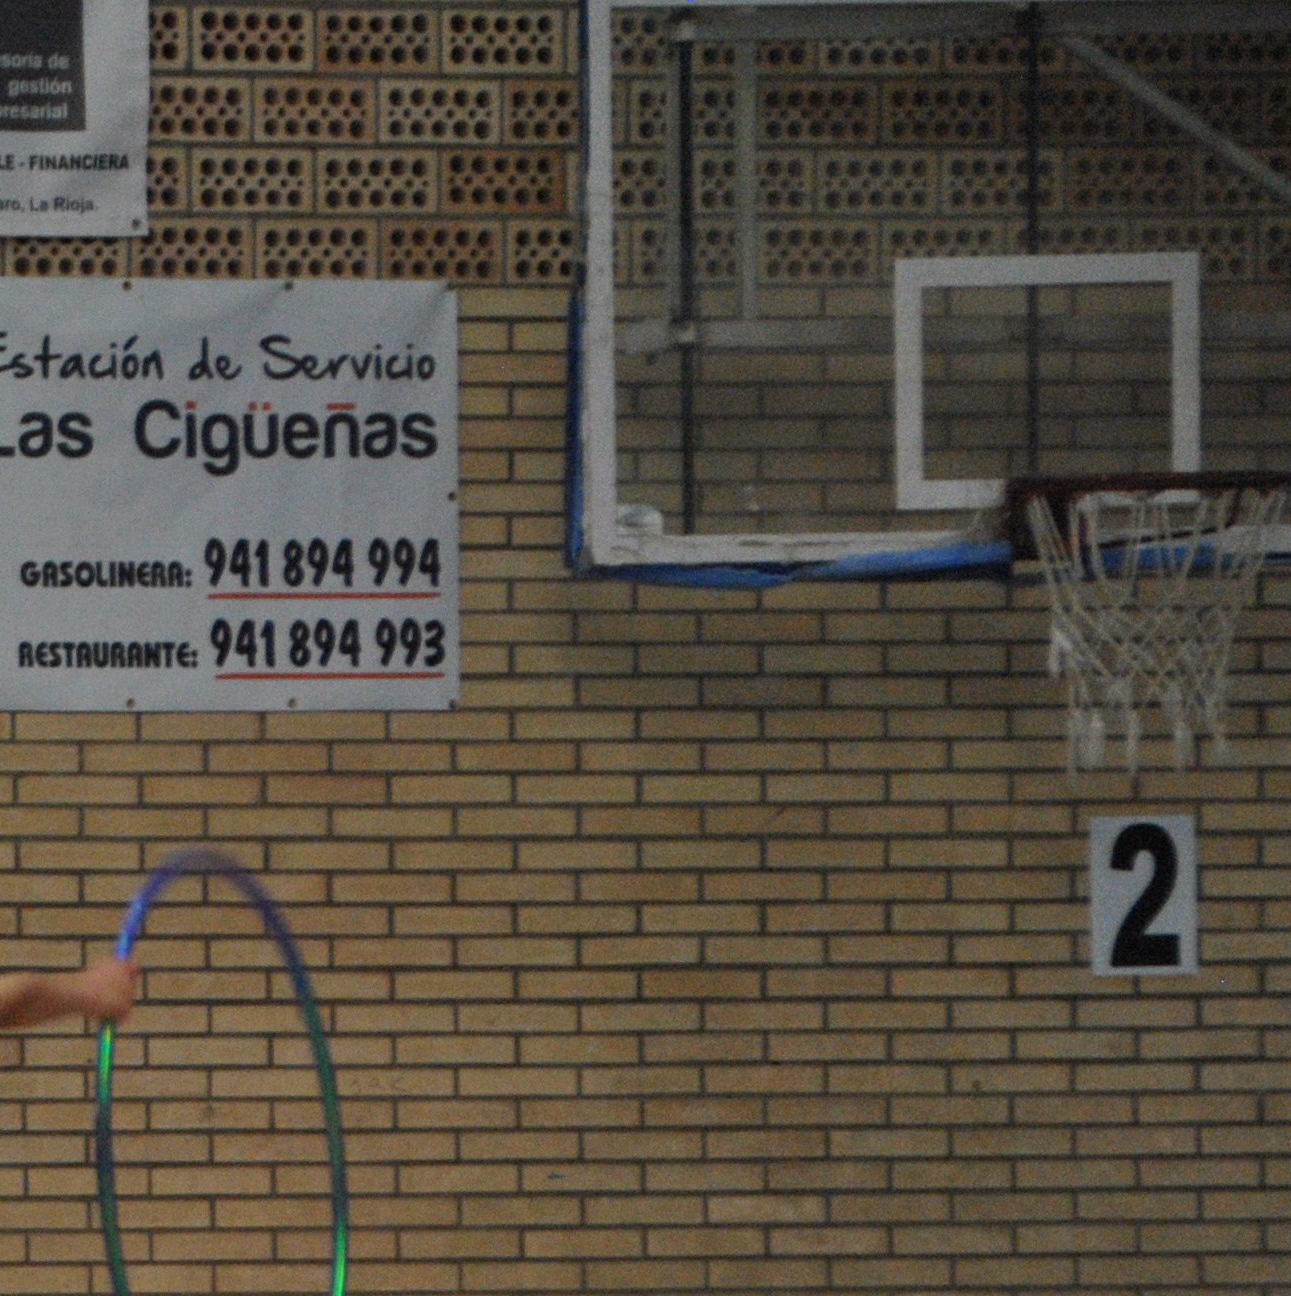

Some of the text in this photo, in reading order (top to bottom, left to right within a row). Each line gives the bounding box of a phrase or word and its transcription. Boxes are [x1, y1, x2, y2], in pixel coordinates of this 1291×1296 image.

[47, 51, 70, 70] de
[28, 153, 130, 172] FINANCIERA
[29, 196, 49, 213] La
[188, 336, 242, 382] de
[259, 334, 436, 382] Servicio
[134, 400, 439, 477] Cigüeñas
[20, 537, 442, 588] GASOLINERA: 941 894 994
[19, 618, 446, 669] RESTAURANTE: 941 894 993
[1110, 822, 1180, 967] 2
